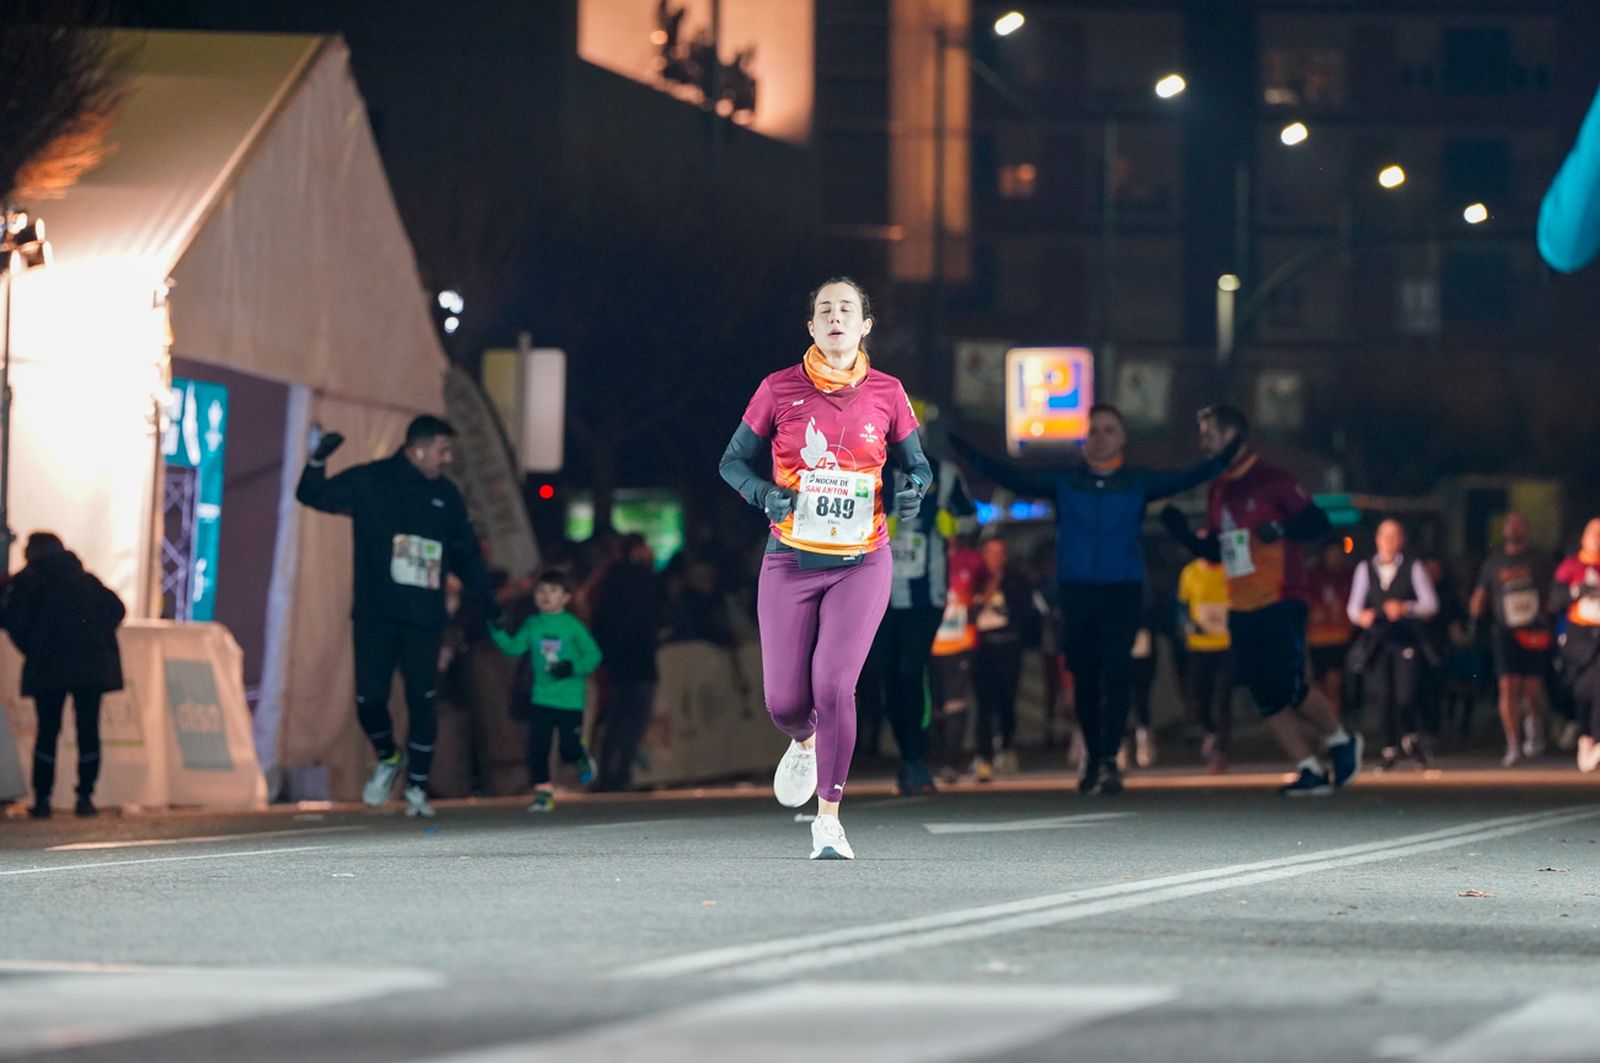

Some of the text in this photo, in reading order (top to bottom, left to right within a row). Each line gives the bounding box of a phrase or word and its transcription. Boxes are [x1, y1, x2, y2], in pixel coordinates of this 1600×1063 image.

[1023, 355, 1074, 409] P
[805, 485, 821, 493] SAN
[815, 478, 838, 486] NOCHE
[816, 495, 855, 520] 849
